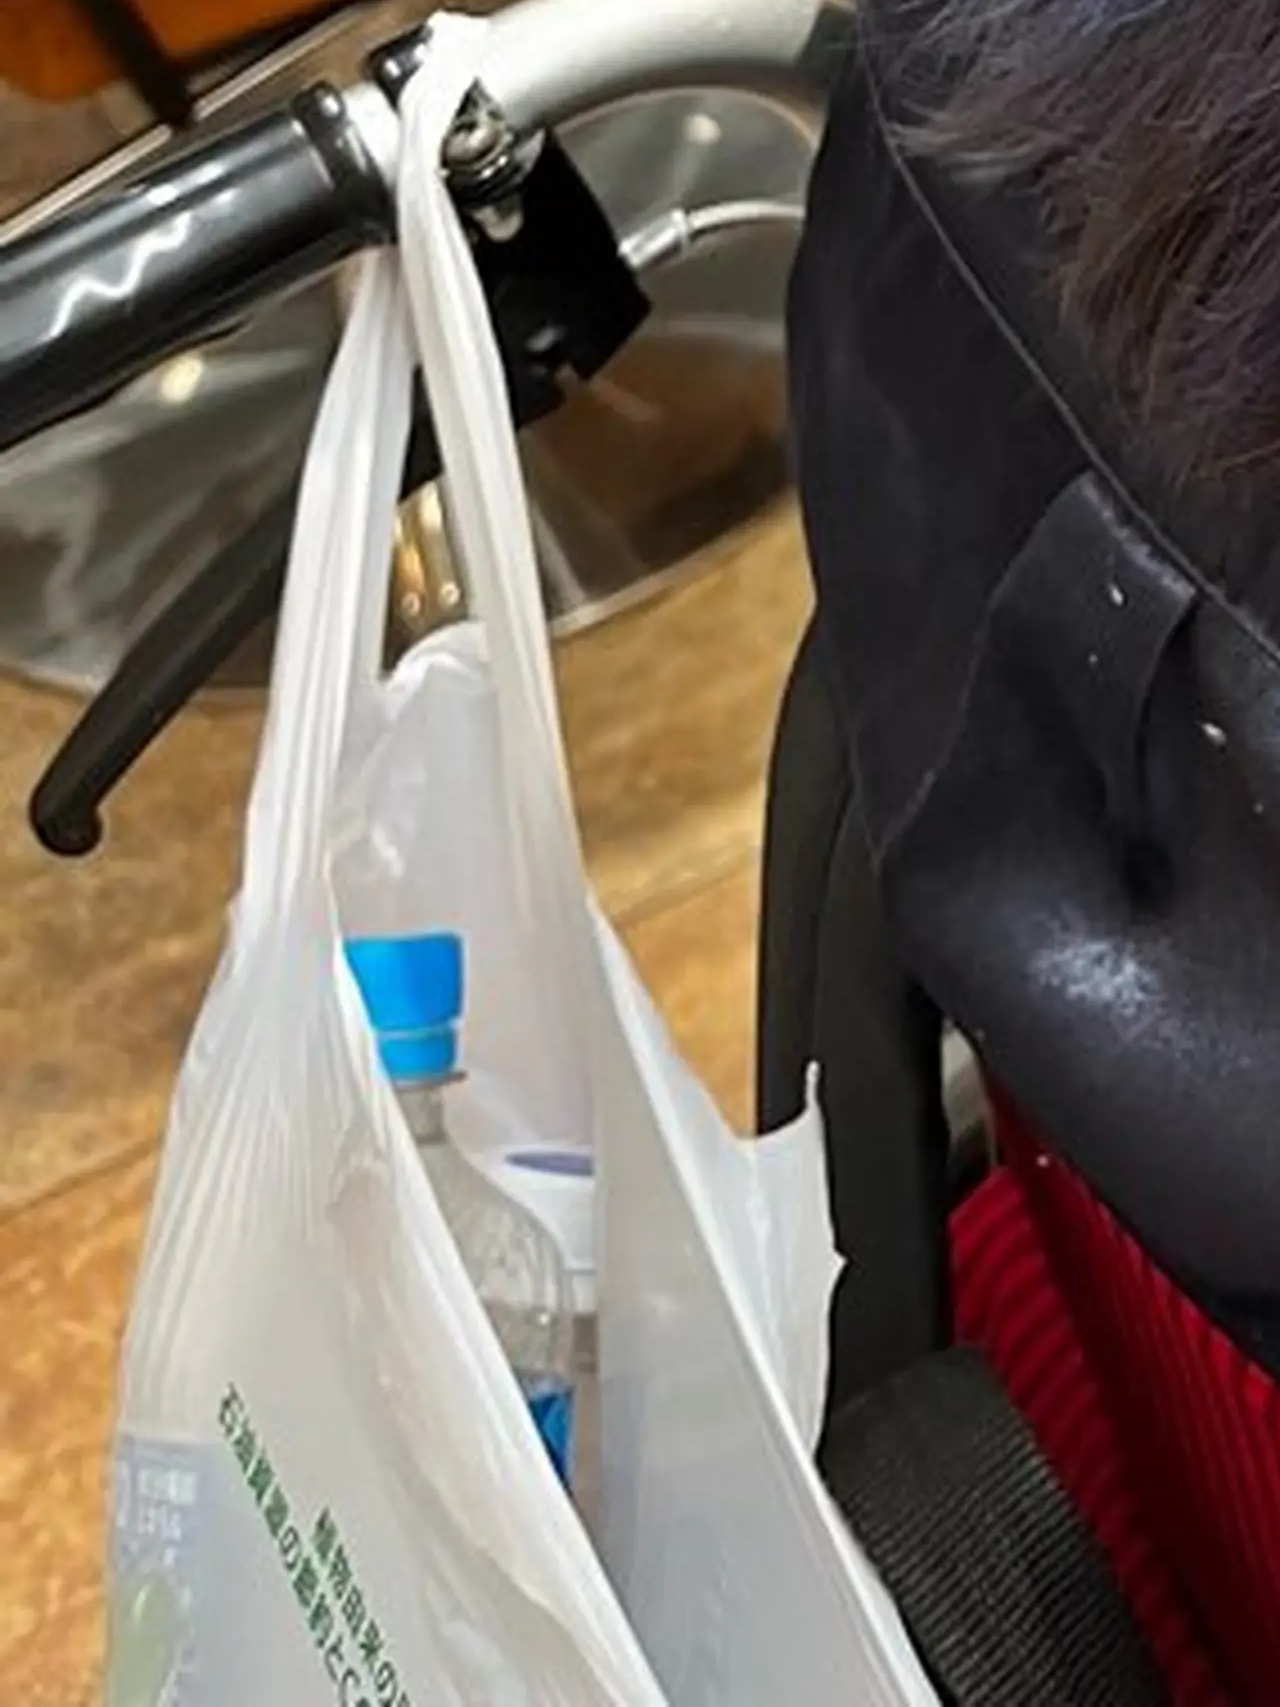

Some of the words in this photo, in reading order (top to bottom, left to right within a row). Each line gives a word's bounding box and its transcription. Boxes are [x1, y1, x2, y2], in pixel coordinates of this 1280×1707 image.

[311, 1506, 411, 1707] 植物由来の
